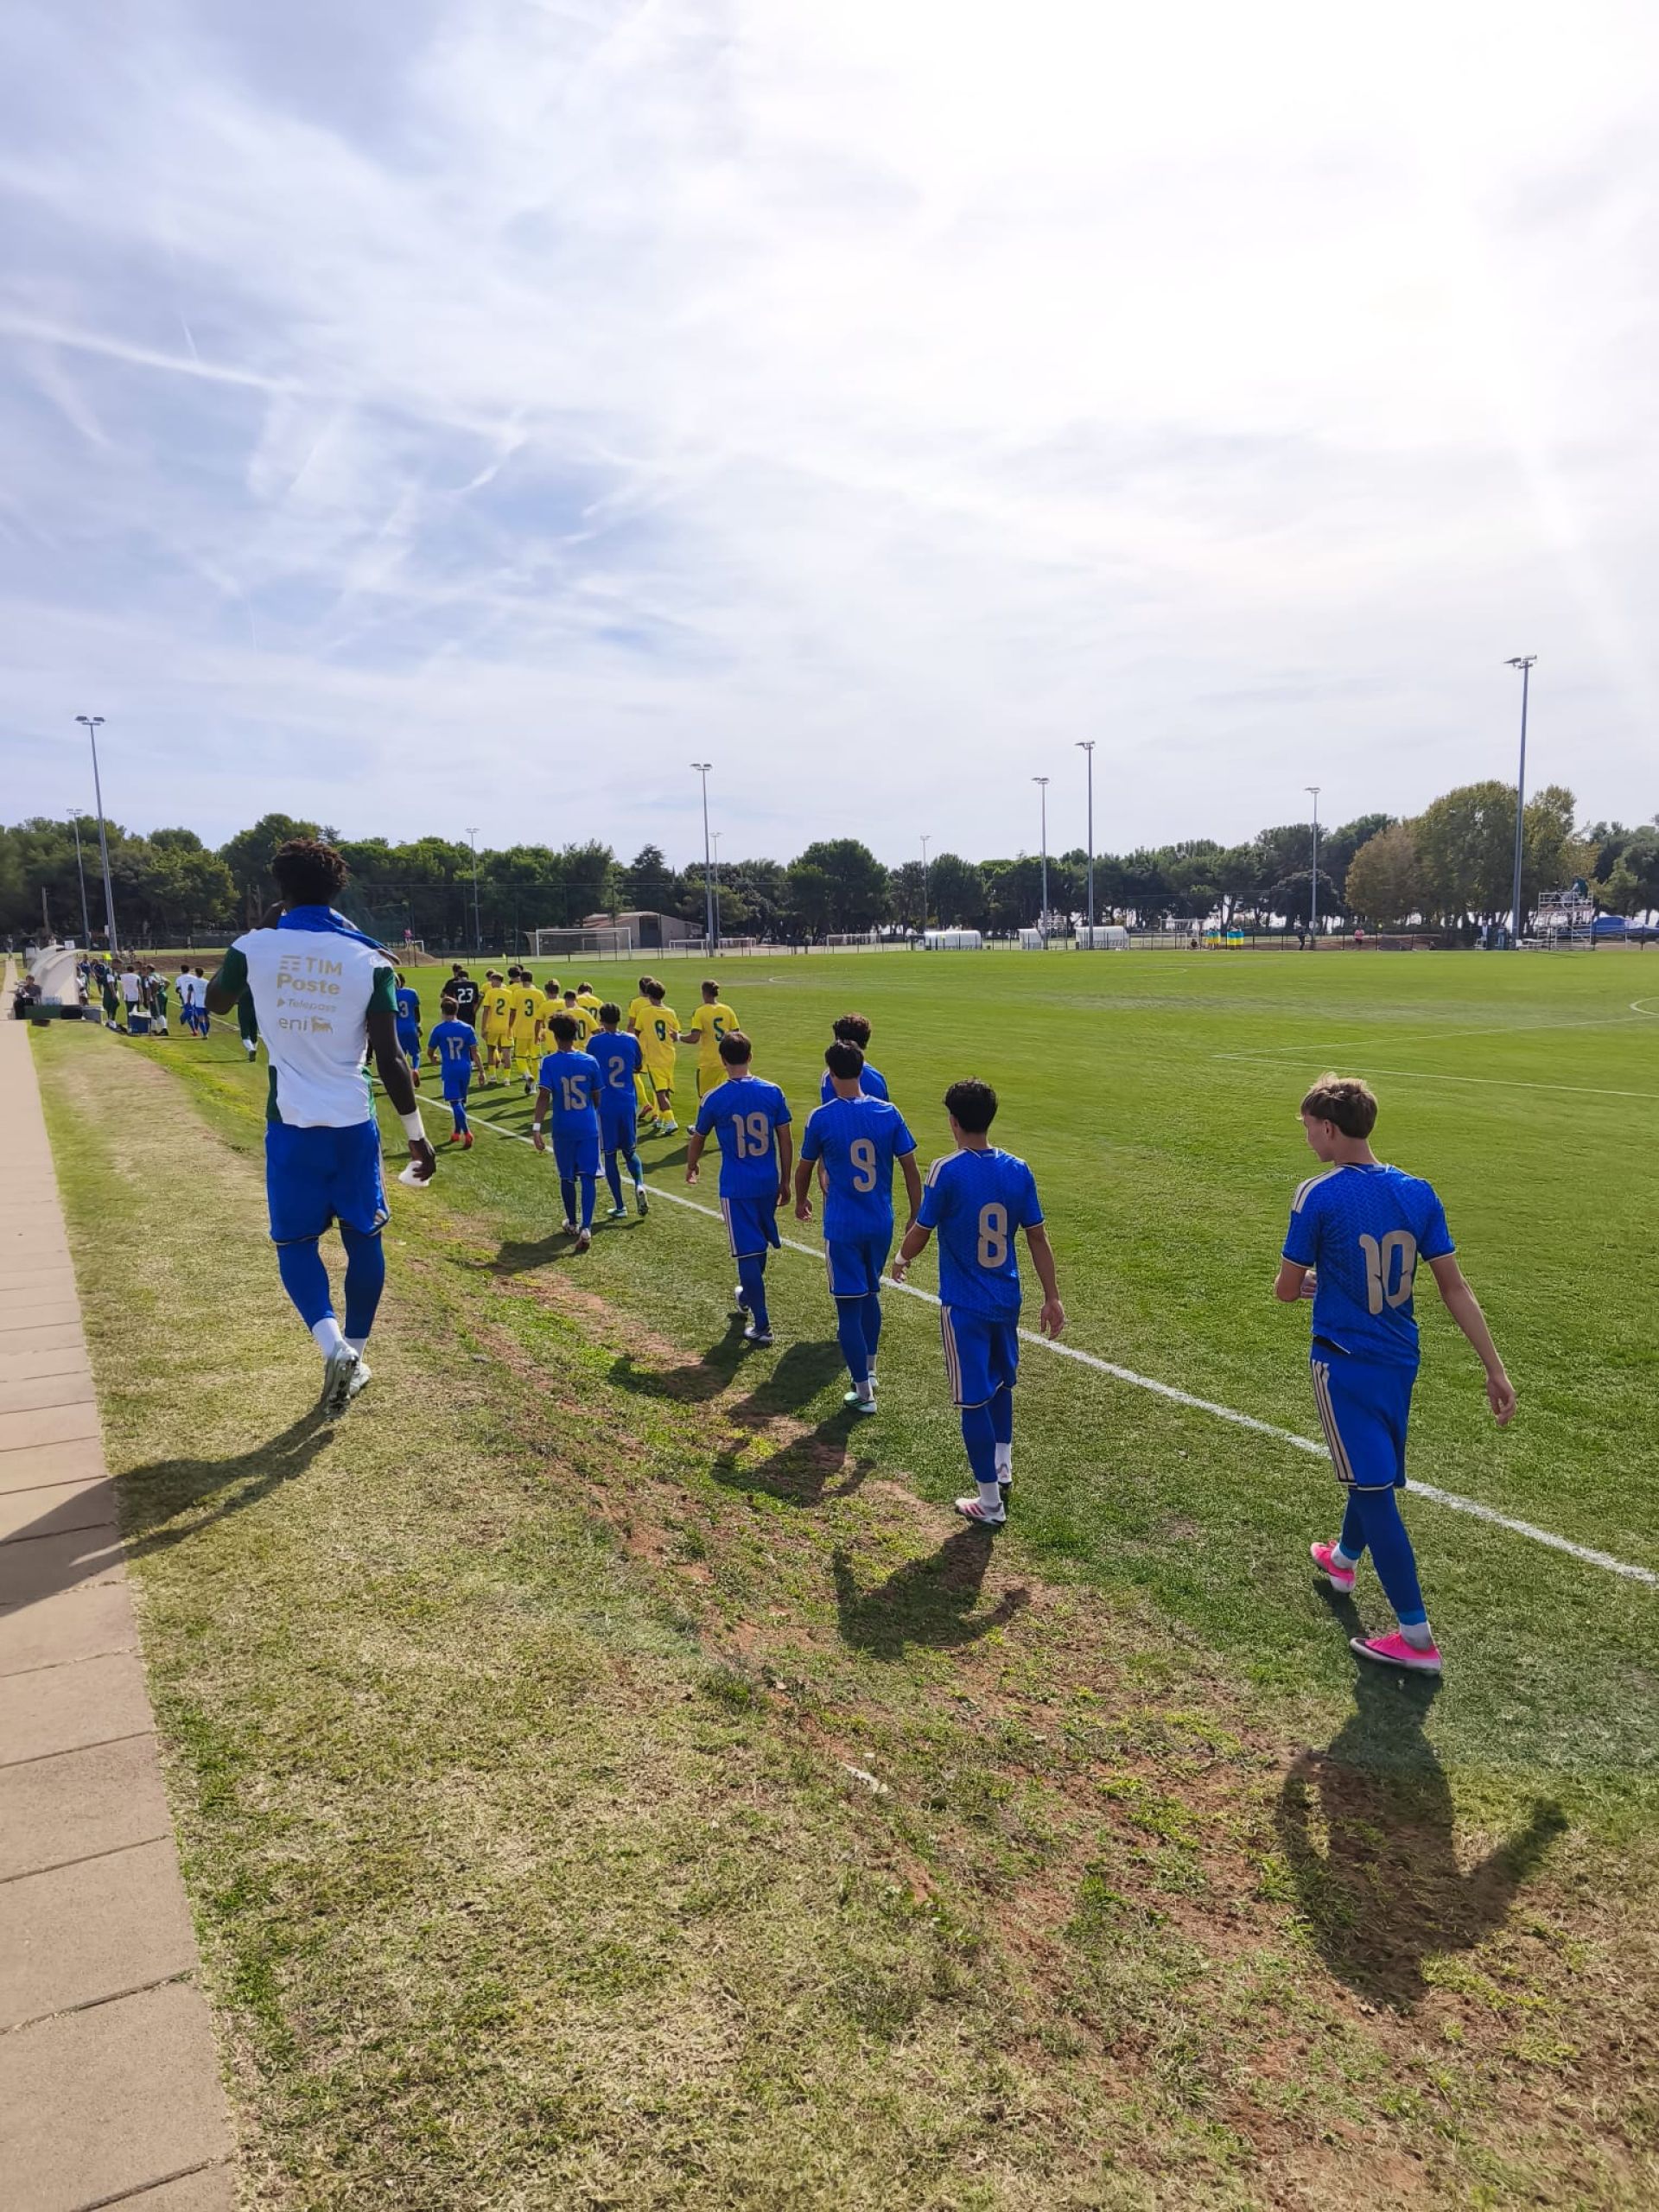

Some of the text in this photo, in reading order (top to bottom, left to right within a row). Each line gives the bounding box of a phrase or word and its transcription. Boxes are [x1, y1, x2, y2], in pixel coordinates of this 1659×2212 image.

[306, 957, 343, 976] TIM
[276, 973, 340, 995] Poste
[457, 988, 474, 1003] 23
[496, 998, 506, 1015] 2
[524, 999, 534, 1016] 3
[278, 1017, 308, 1031] eni
[713, 1017, 727, 1042] 5
[446, 1037, 464, 1060] 17
[608, 1056, 626, 1088] 2
[561, 1075, 588, 1111] 15
[732, 1112, 769, 1159] 19
[850, 1138, 877, 1192] 9
[977, 1202, 1008, 1268] 8
[1359, 1230, 1417, 1315] 10
